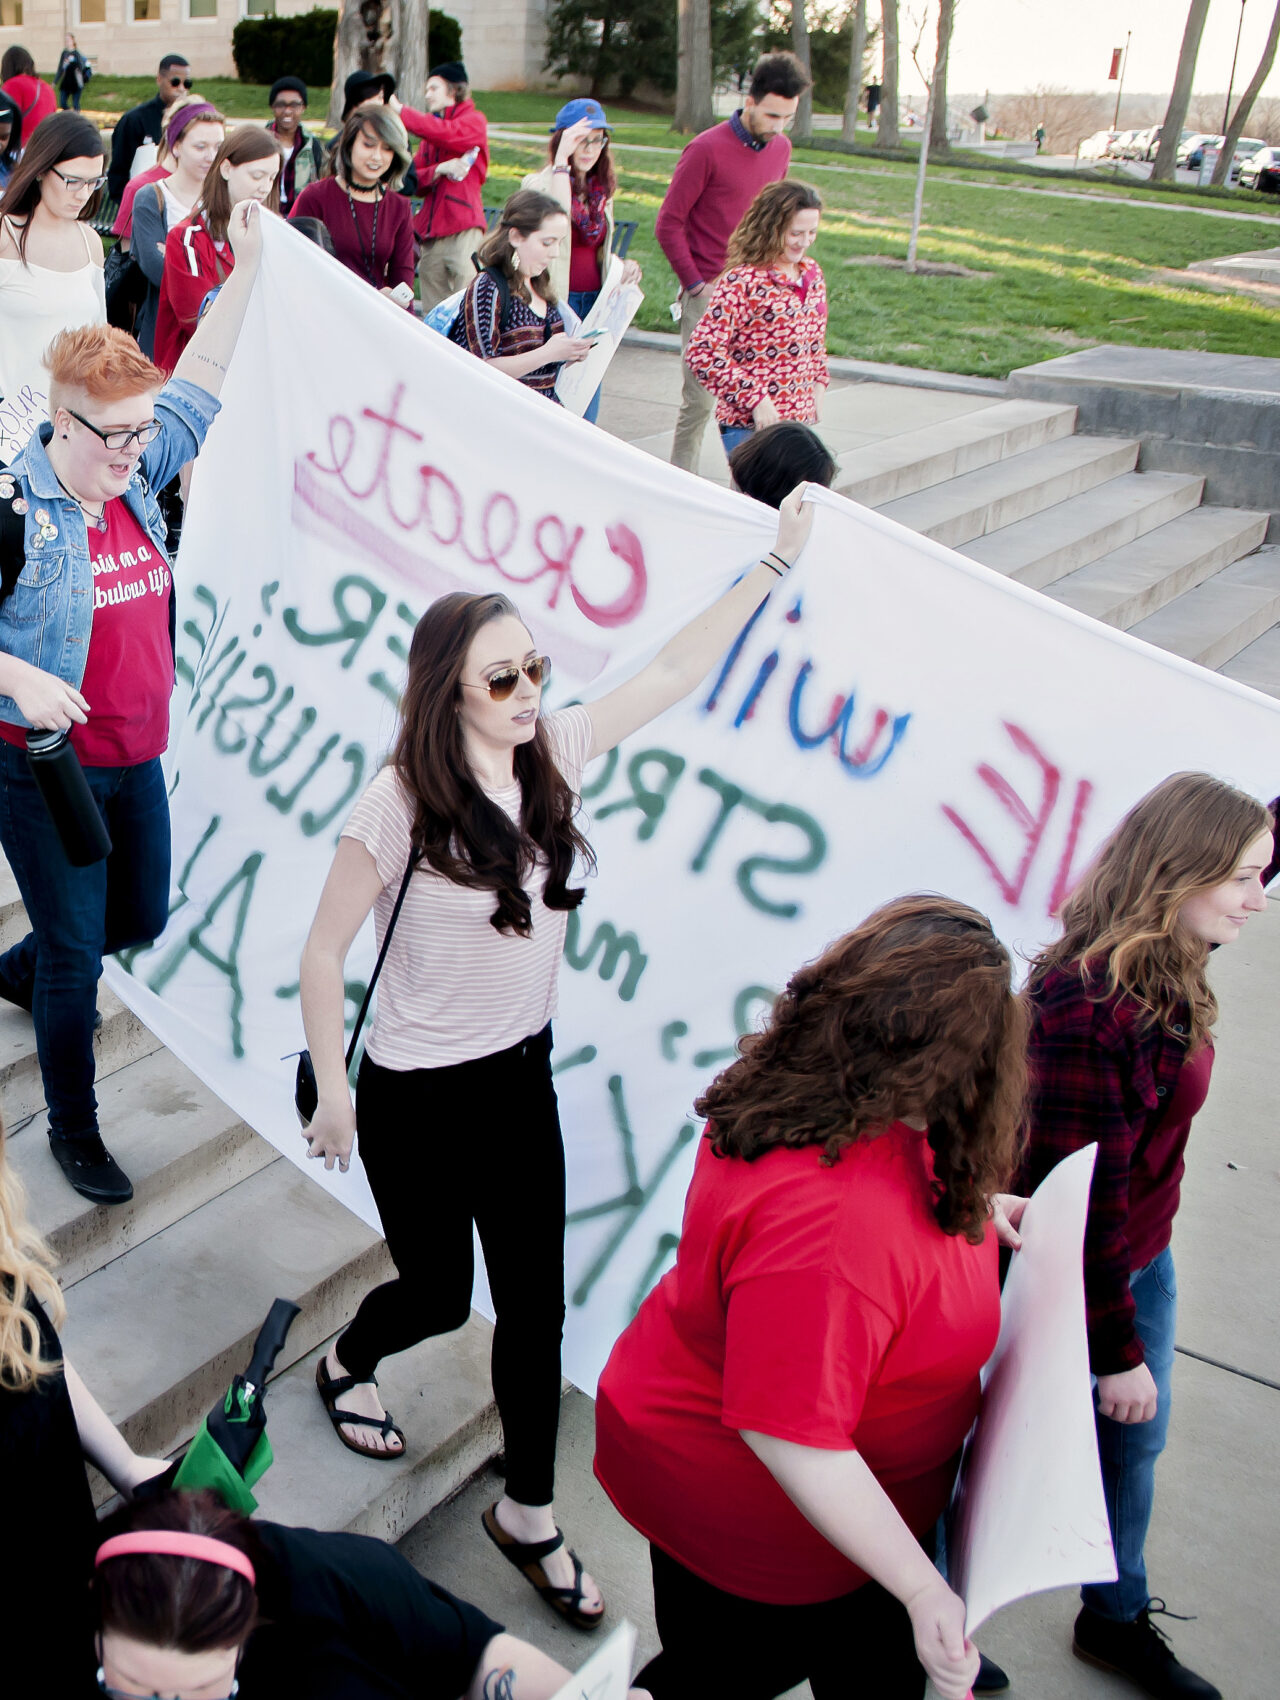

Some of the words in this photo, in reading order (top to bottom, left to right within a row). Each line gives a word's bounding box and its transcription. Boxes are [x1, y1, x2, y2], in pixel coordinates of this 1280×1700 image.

[119, 550, 138, 569] on
[137, 545, 152, 562] a
[93, 578, 148, 610] bulous
[148, 565, 171, 597] life
